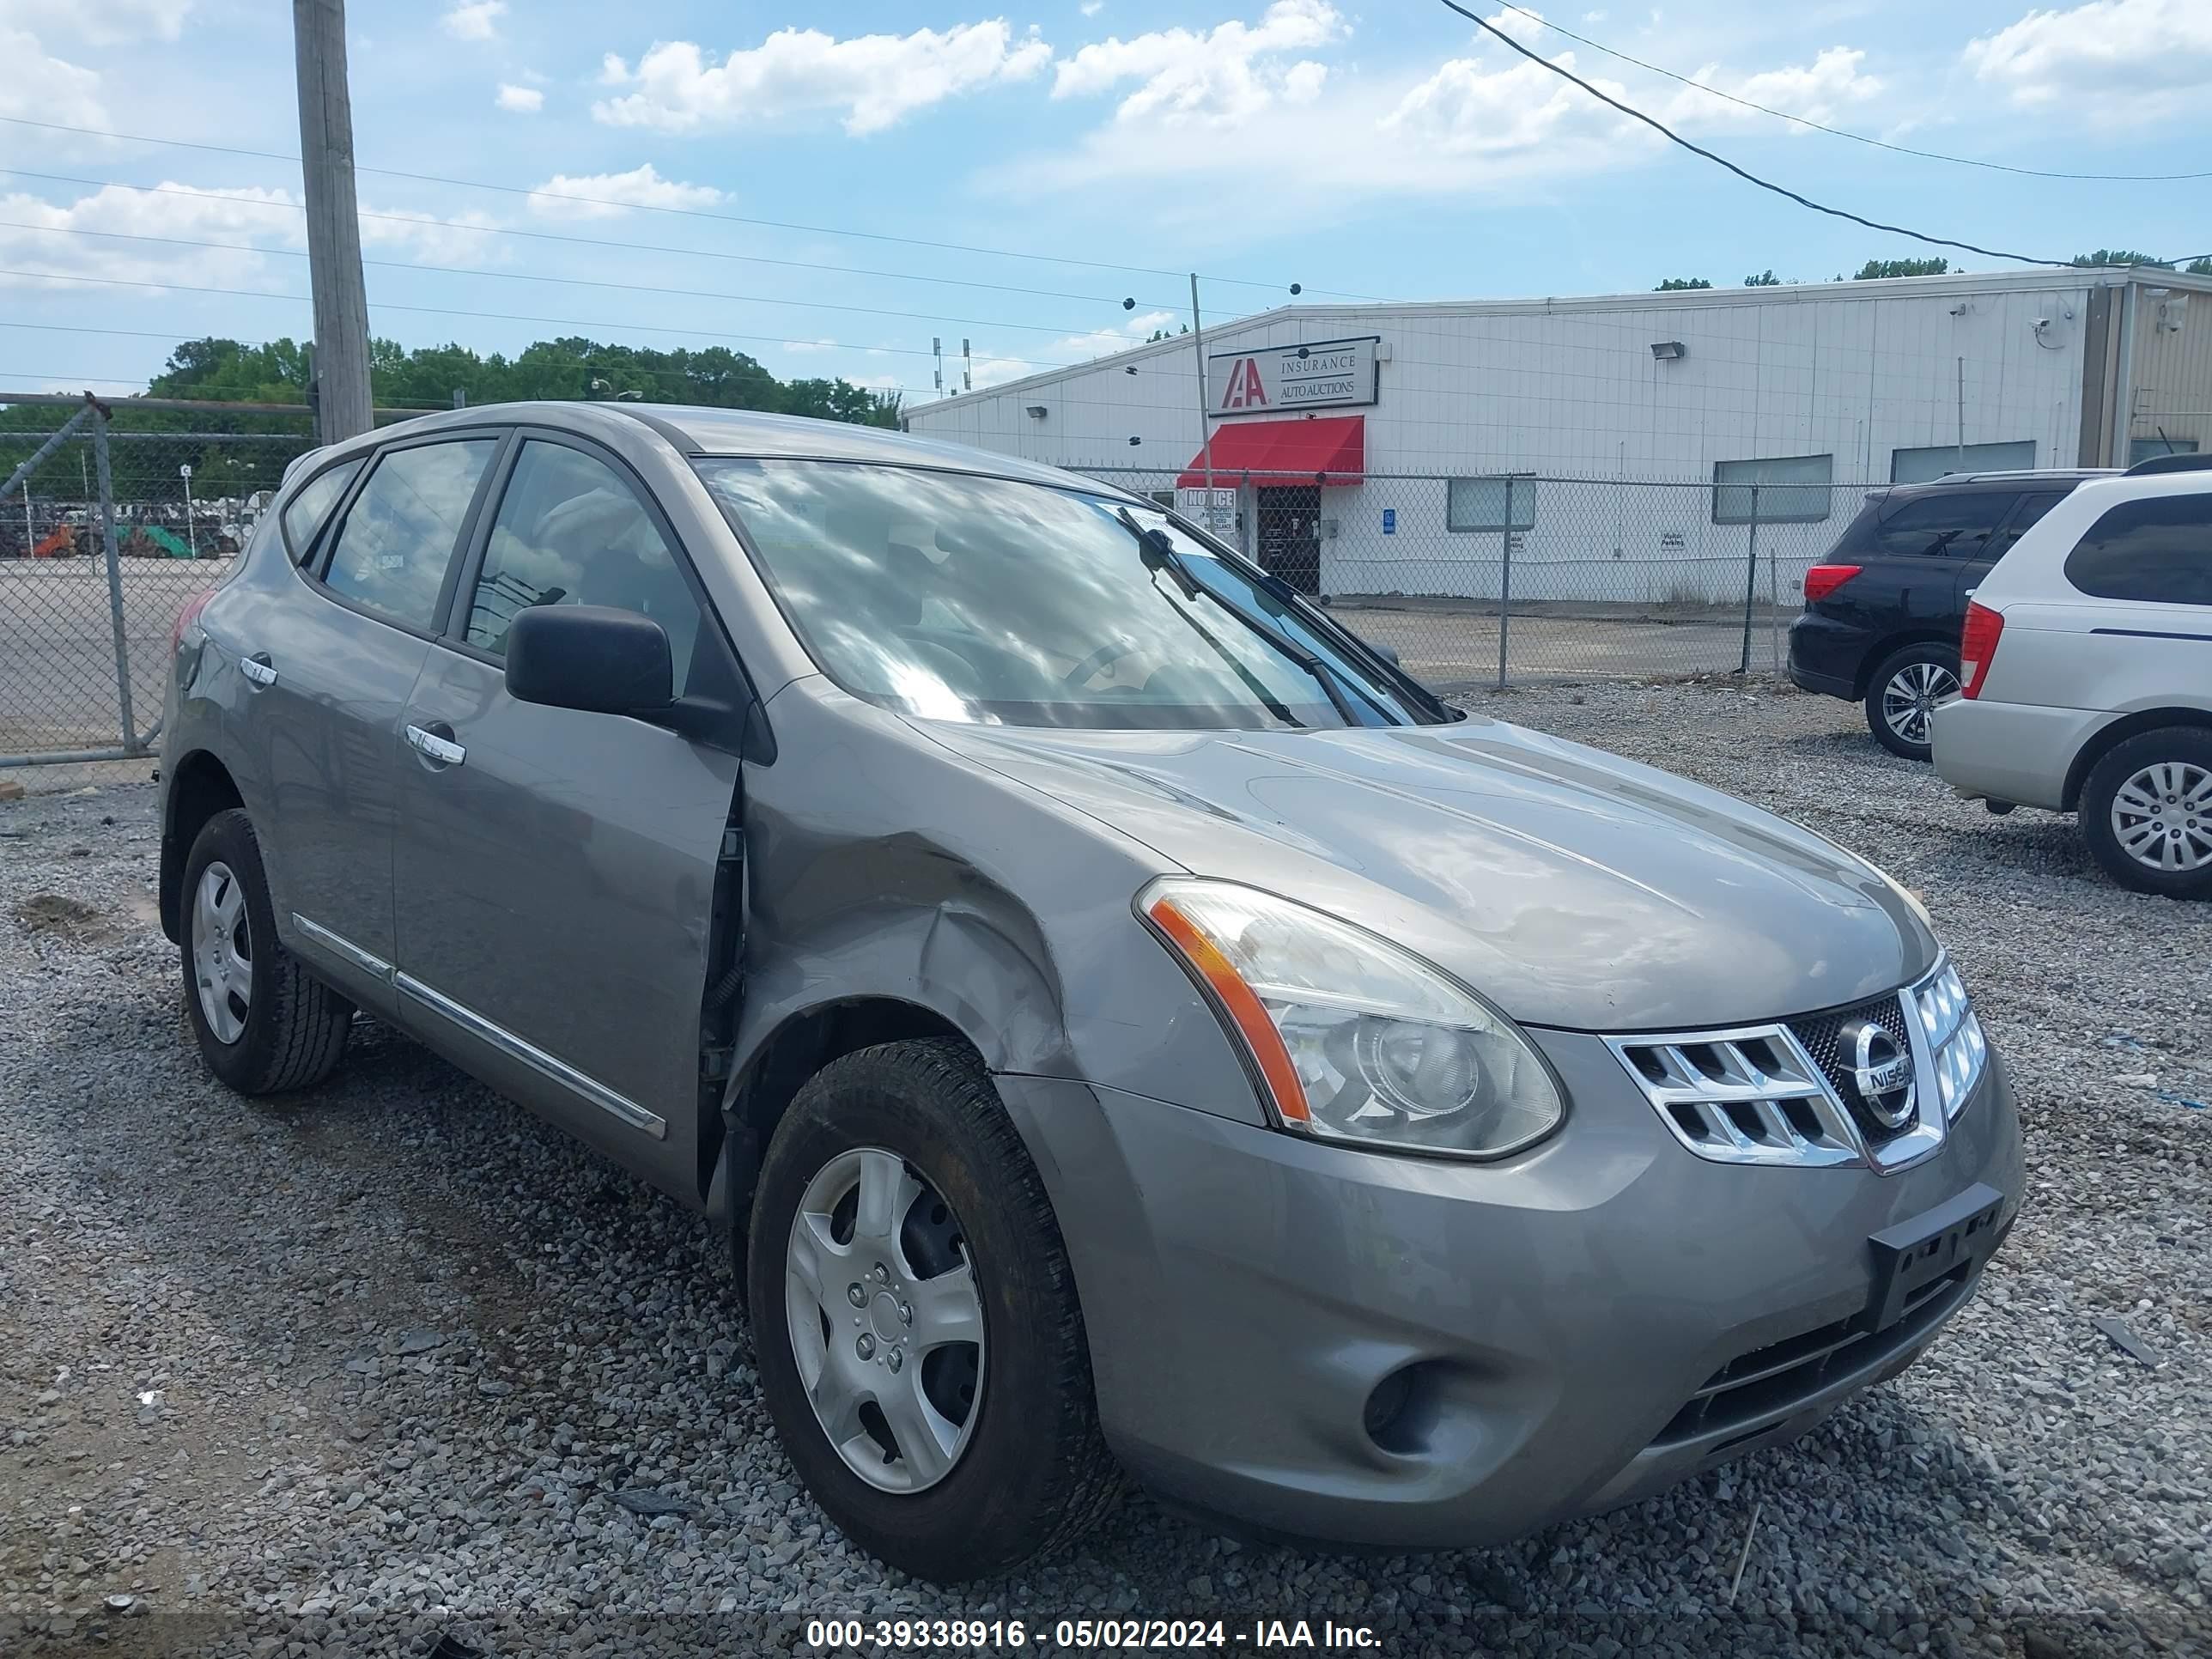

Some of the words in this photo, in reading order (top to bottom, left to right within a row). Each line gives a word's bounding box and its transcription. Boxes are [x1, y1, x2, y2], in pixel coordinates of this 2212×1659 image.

[1281, 356, 1355, 374] INSURANCE
[1280, 384, 1306, 399] AUTO
[1307, 380, 1354, 398] AUCTIONS
